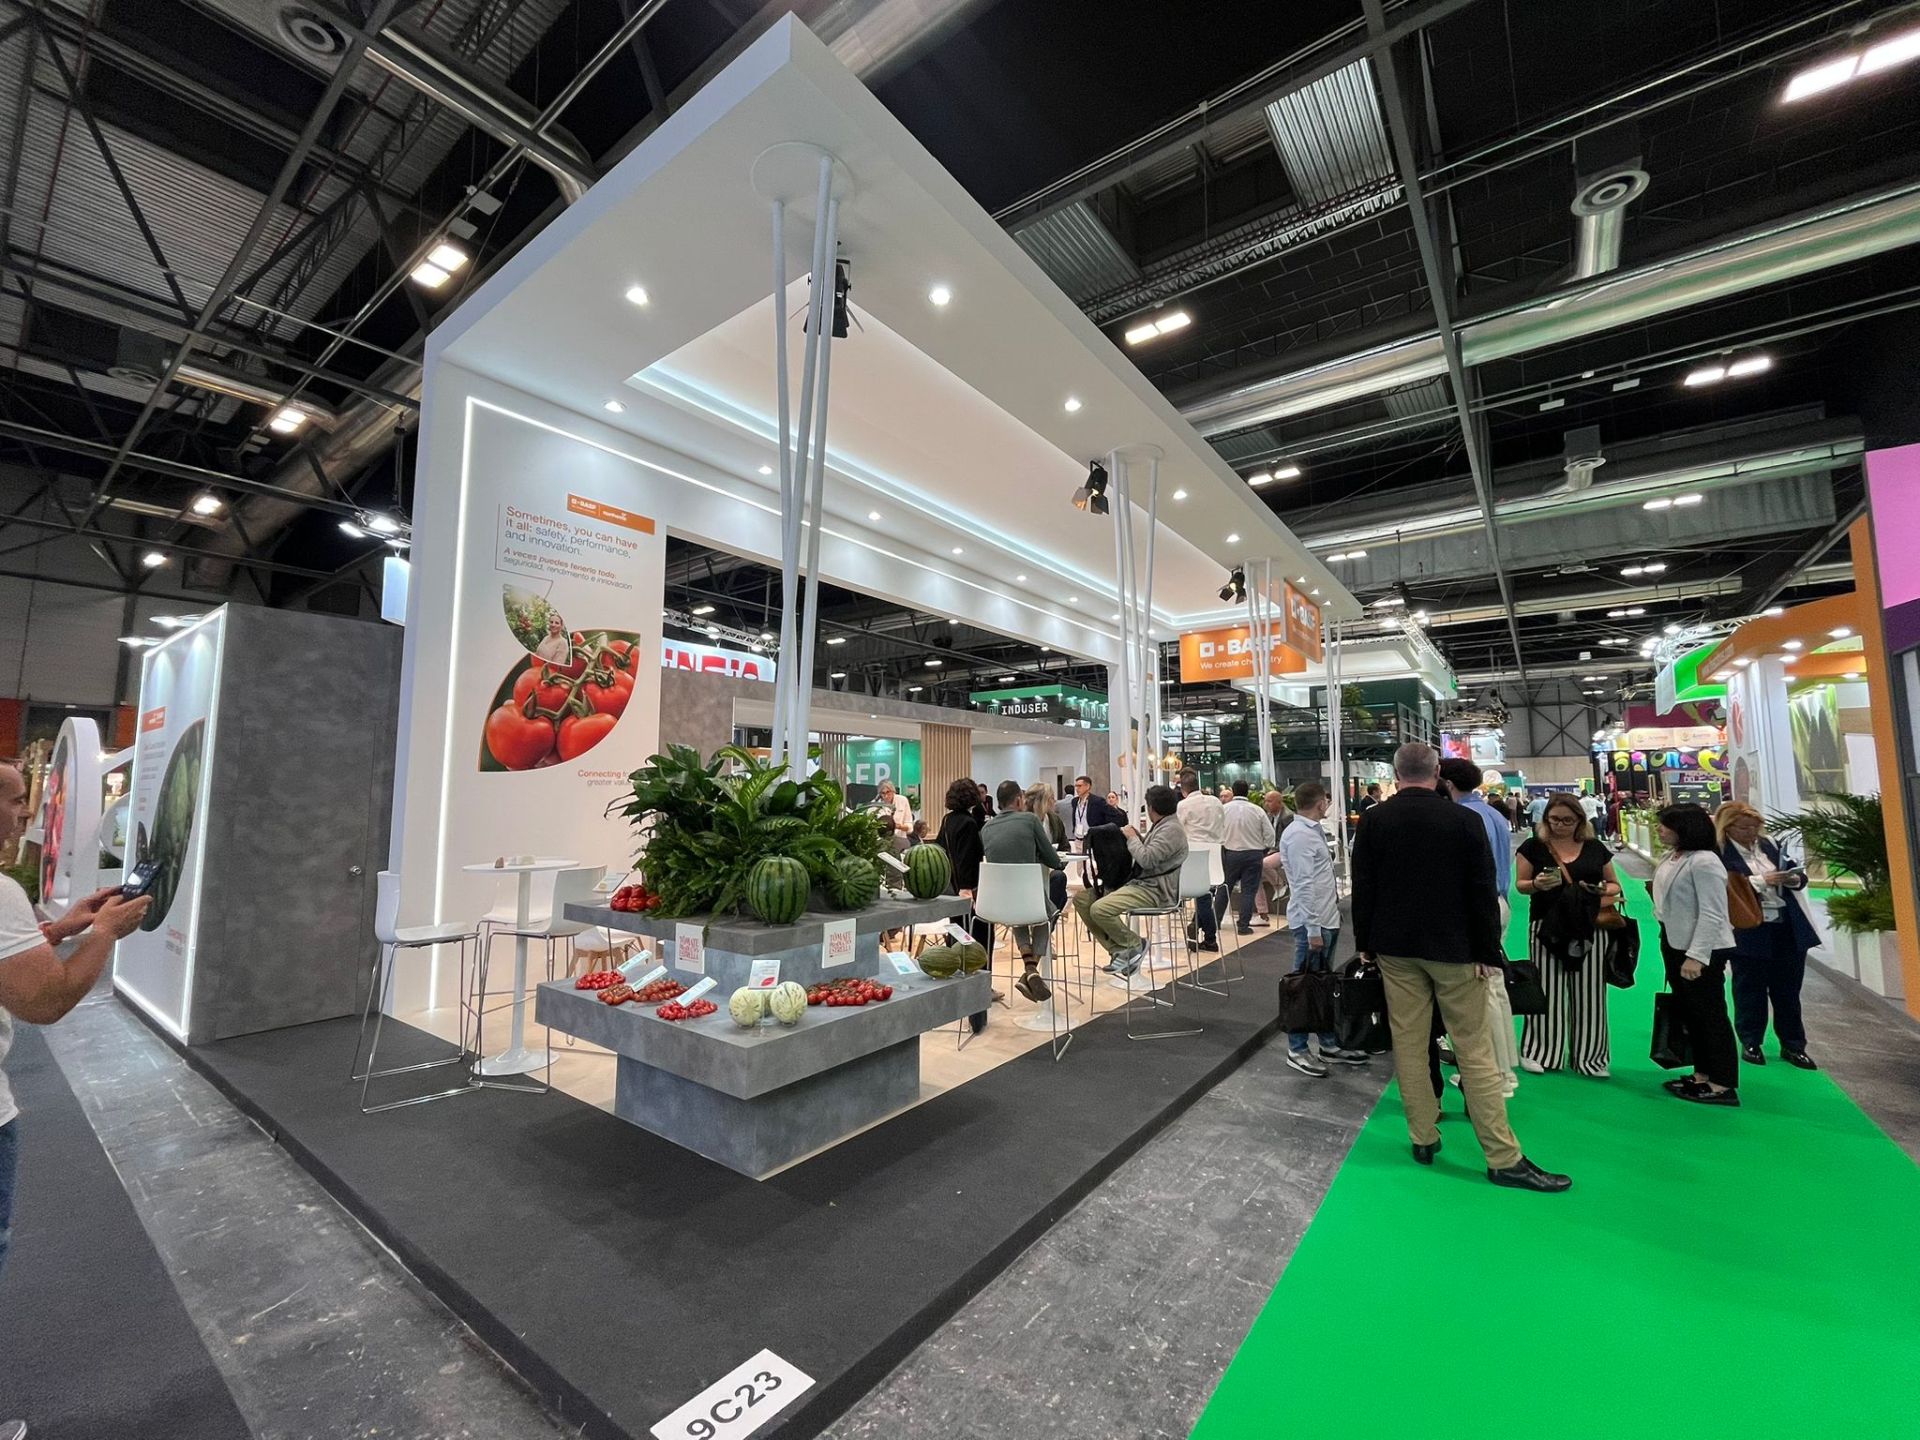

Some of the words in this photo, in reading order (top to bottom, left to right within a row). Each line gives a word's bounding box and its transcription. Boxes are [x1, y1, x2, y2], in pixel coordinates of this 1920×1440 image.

[505, 517, 512, 527] it
[516, 521, 532, 532] all:
[570, 536, 631, 558] performance,
[506, 505, 571, 532] Sometimes,
[575, 526, 593, 538] you
[595, 532, 612, 542] can
[616, 536, 638, 549] have
[505, 530, 525, 542] and
[529, 536, 582, 556] innovation.
[513, 549, 537, 560] veces
[539, 556, 568, 569] puedes
[1200, 661, 1213, 670] We
[1214, 658, 1240, 669] create
[1241, 655, 1282, 666] chtry
[1001, 702, 1048, 715] INDUSER
[577, 769, 622, 778] Connecting
[686, 1371, 782, 1440] 9C23
